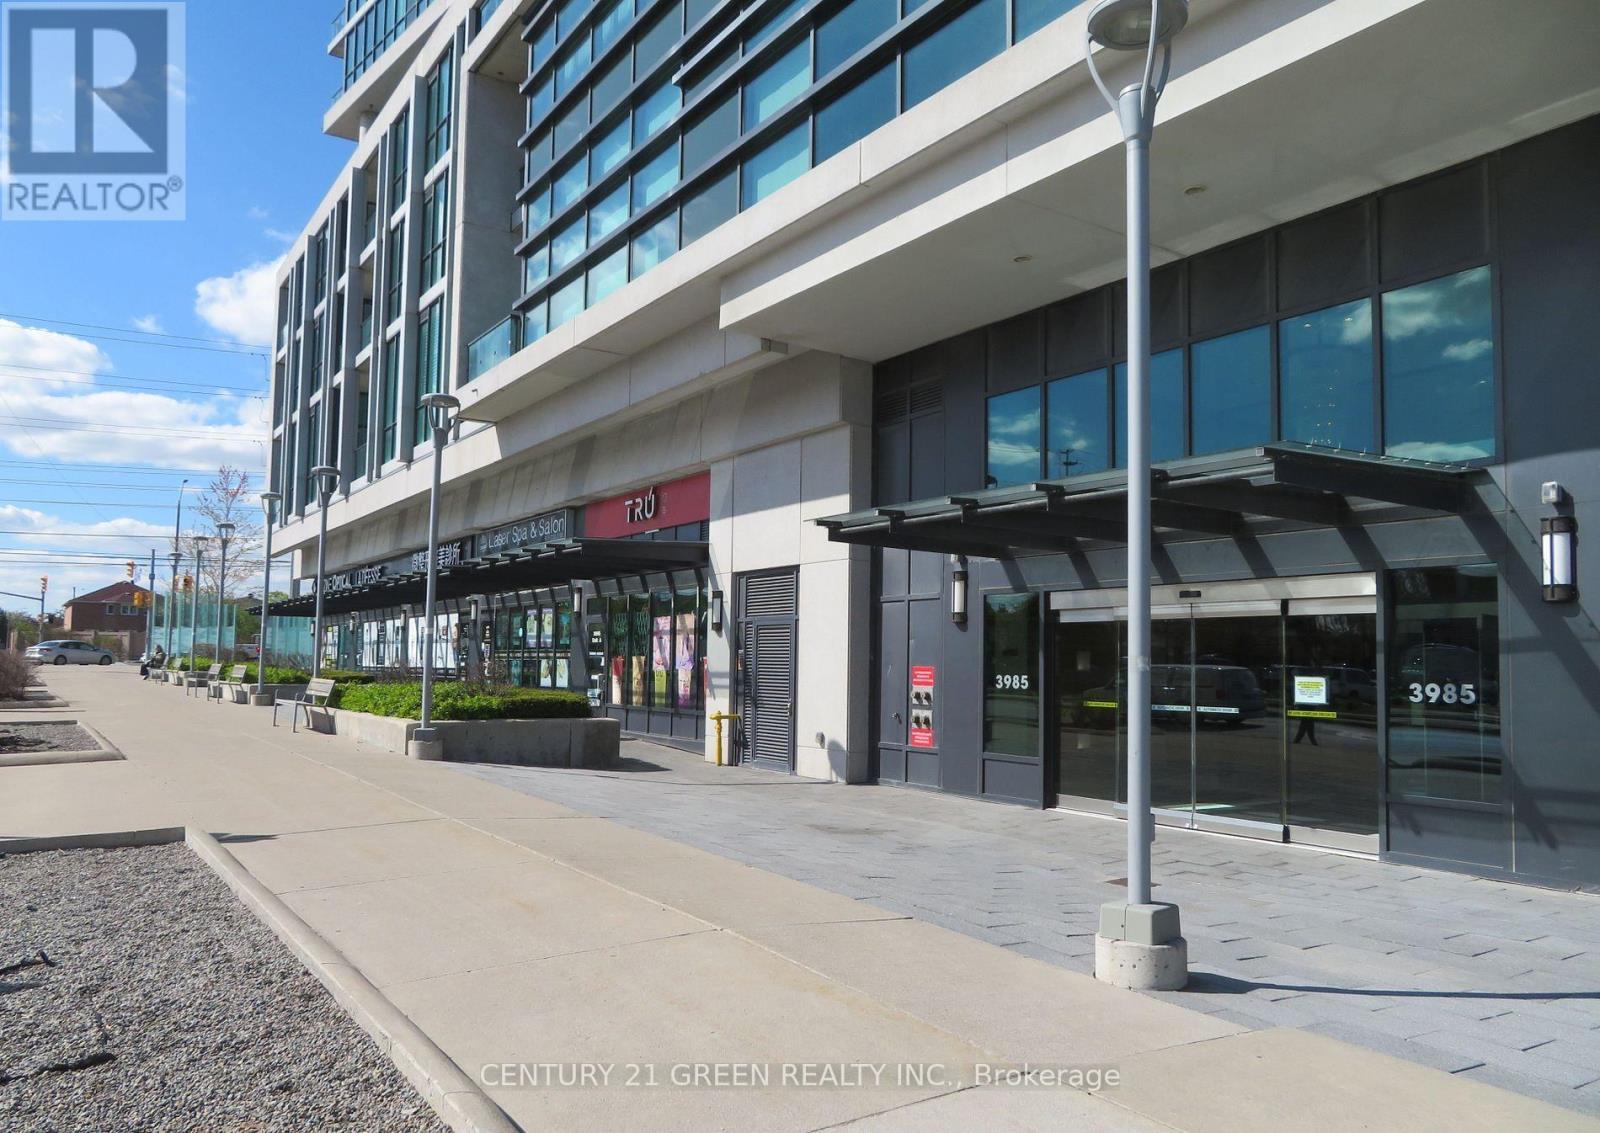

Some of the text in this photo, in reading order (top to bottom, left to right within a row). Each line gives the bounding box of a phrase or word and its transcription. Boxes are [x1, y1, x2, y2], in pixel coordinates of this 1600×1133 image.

[488, 517, 564, 549] Laser Spa & Salon
[995, 675, 1029, 690] 3985
[1409, 682, 1476, 705] 3985
